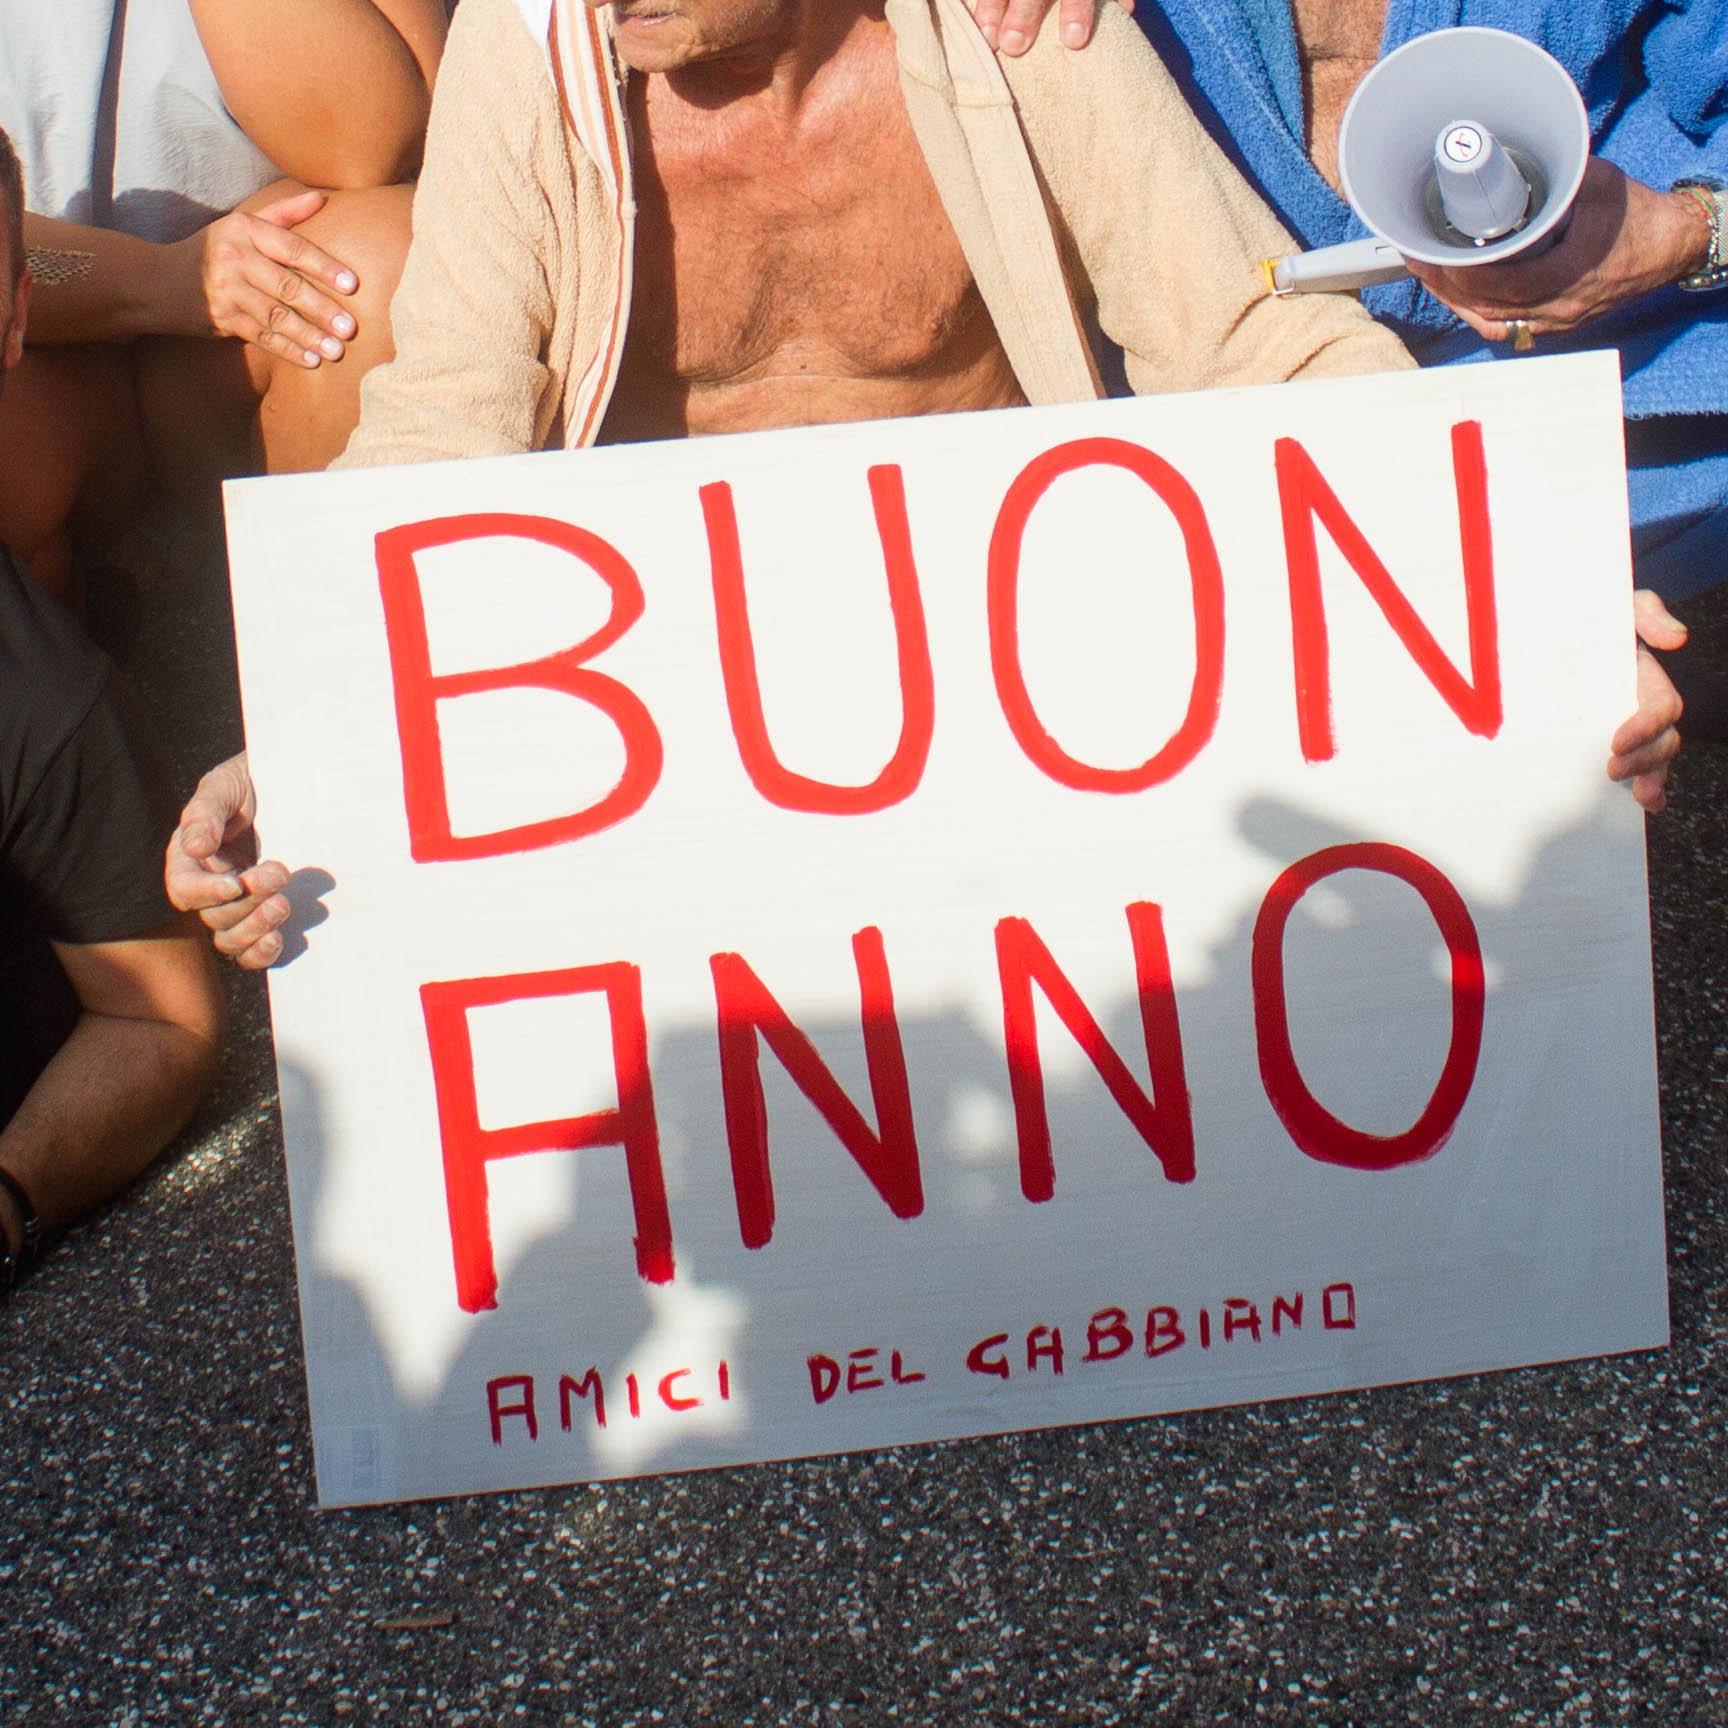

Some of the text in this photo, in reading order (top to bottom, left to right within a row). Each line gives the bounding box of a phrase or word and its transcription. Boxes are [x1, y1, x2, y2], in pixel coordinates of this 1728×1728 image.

[375, 419, 1504, 864] BUON
[418, 841, 1486, 1314] ANNO
[487, 1282, 1355, 1446] AMICI DEL GABBIANO
